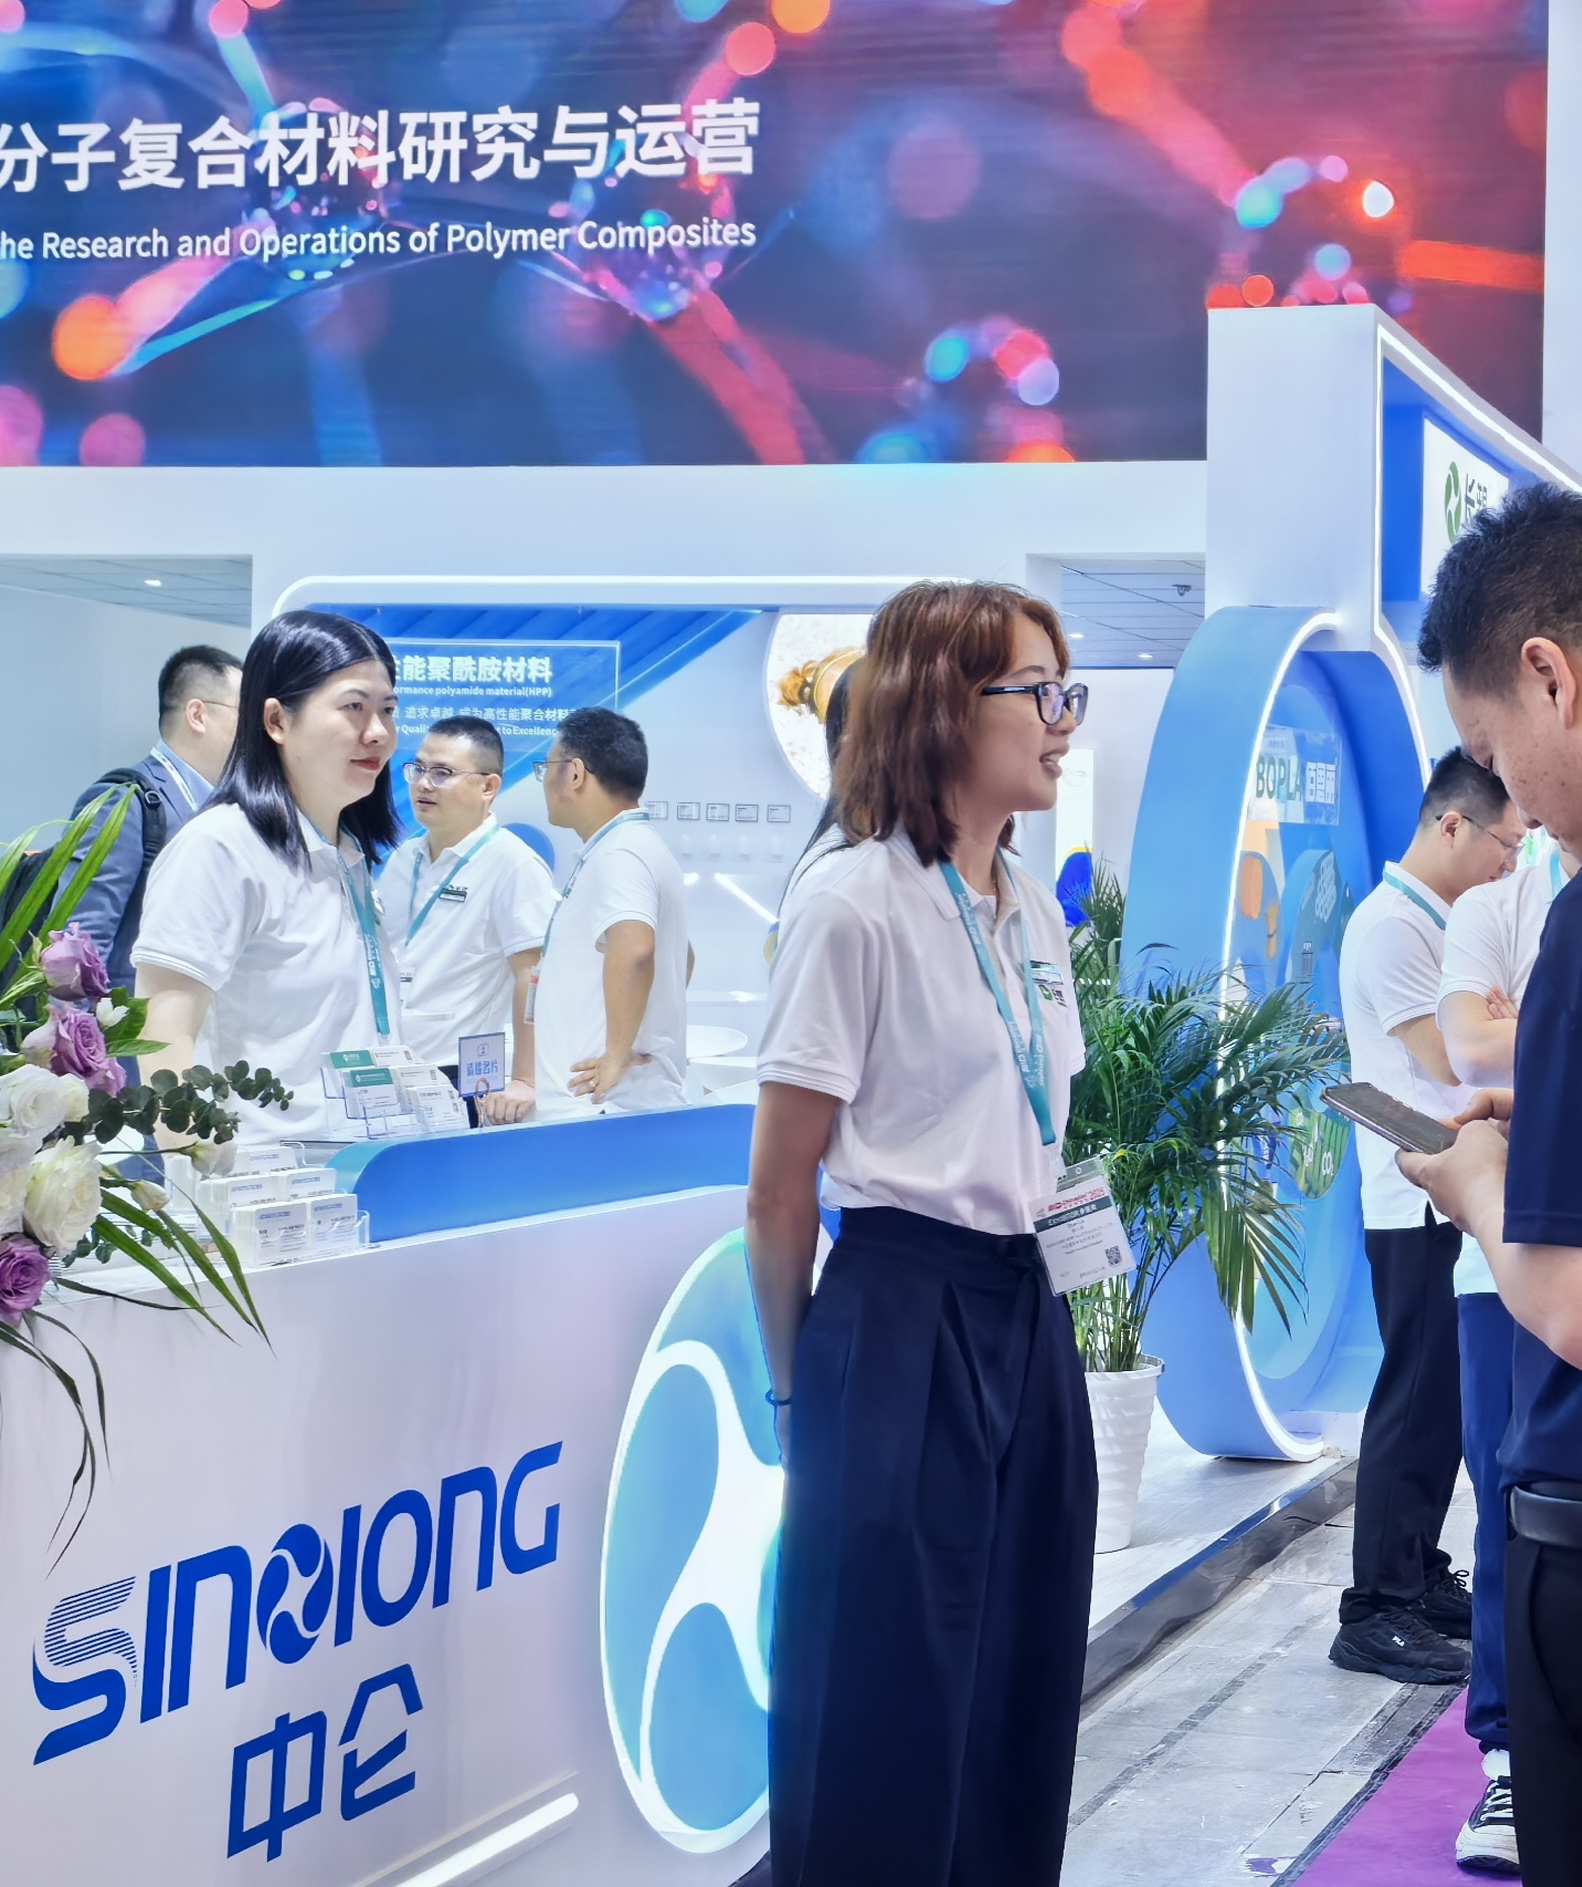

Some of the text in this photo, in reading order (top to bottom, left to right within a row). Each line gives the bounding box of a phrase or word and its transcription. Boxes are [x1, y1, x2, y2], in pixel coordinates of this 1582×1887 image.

[0, 97, 759, 192] 分子复合材料研究与运营
[42, 228, 169, 260] Research
[177, 227, 231, 258] and
[240, 225, 400, 263] Operations
[409, 222, 440, 253] of
[447, 221, 571, 259] Polymer
[577, 217, 757, 256] Composites
[393, 655, 553, 684] 能聚酰胺材料
[513, 724, 560, 737] Excellenc
[226, 1662, 424, 1863] 中仑
